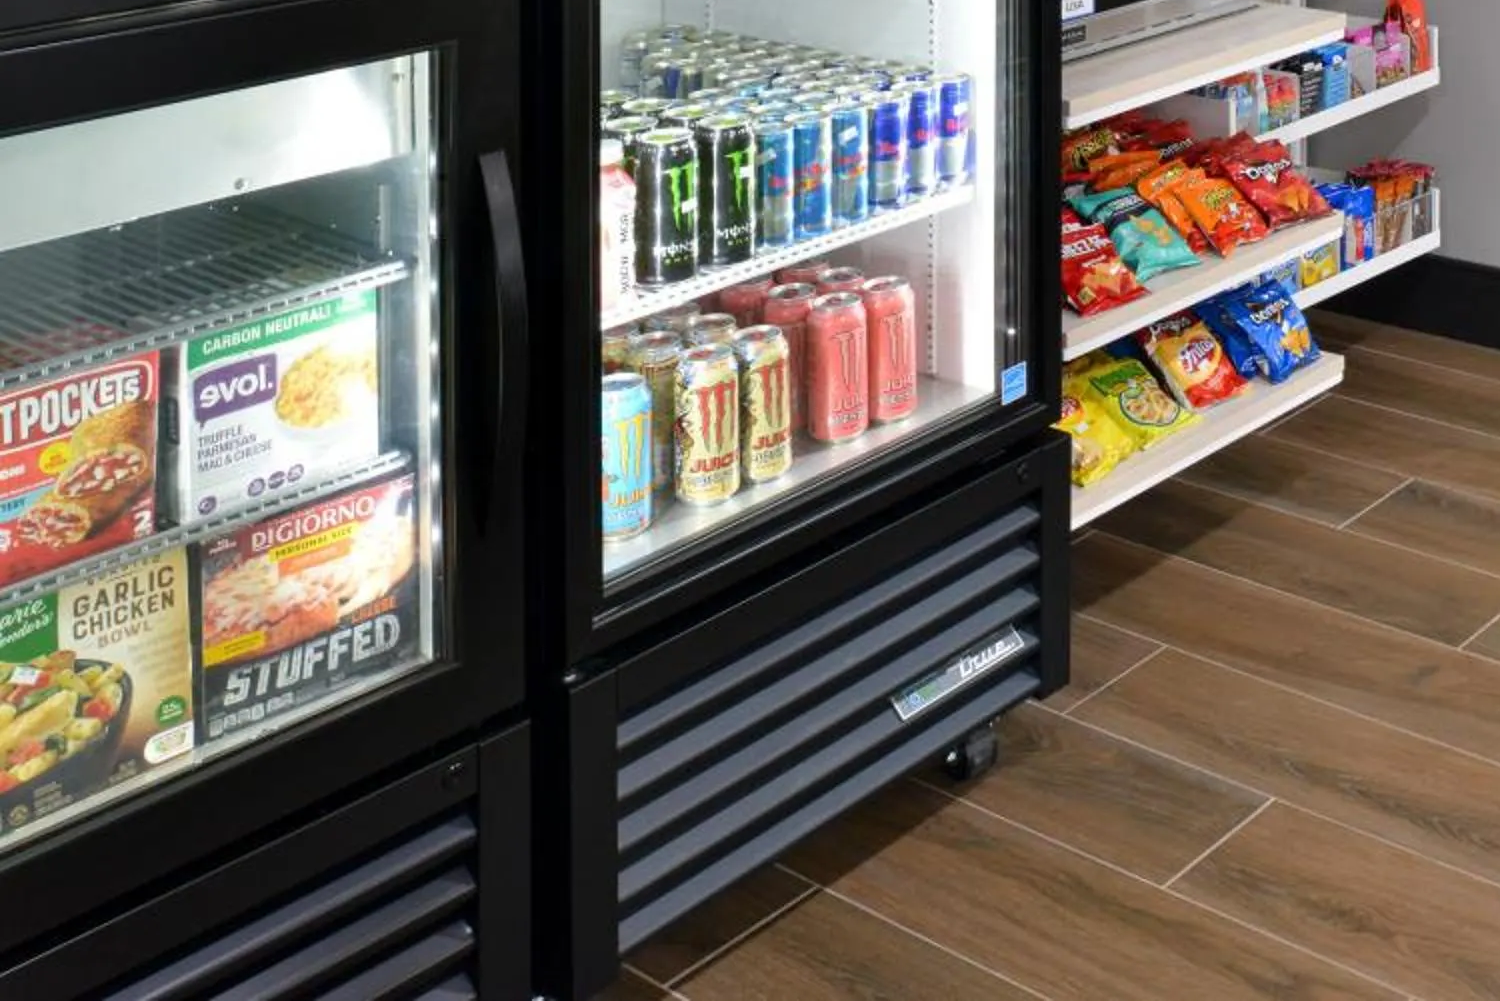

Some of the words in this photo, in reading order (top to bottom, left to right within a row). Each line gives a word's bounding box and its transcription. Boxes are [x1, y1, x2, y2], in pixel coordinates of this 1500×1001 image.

[203, 325, 261, 355] CARBON
[18, 368, 141, 441] POCKETS
[199, 424, 244, 448] TRUFFLE
[73, 565, 174, 618] GARLIC
[73, 589, 175, 641] CHICKEN
[97, 621, 153, 649] BOWL
[223, 614, 401, 707] STUFFED
